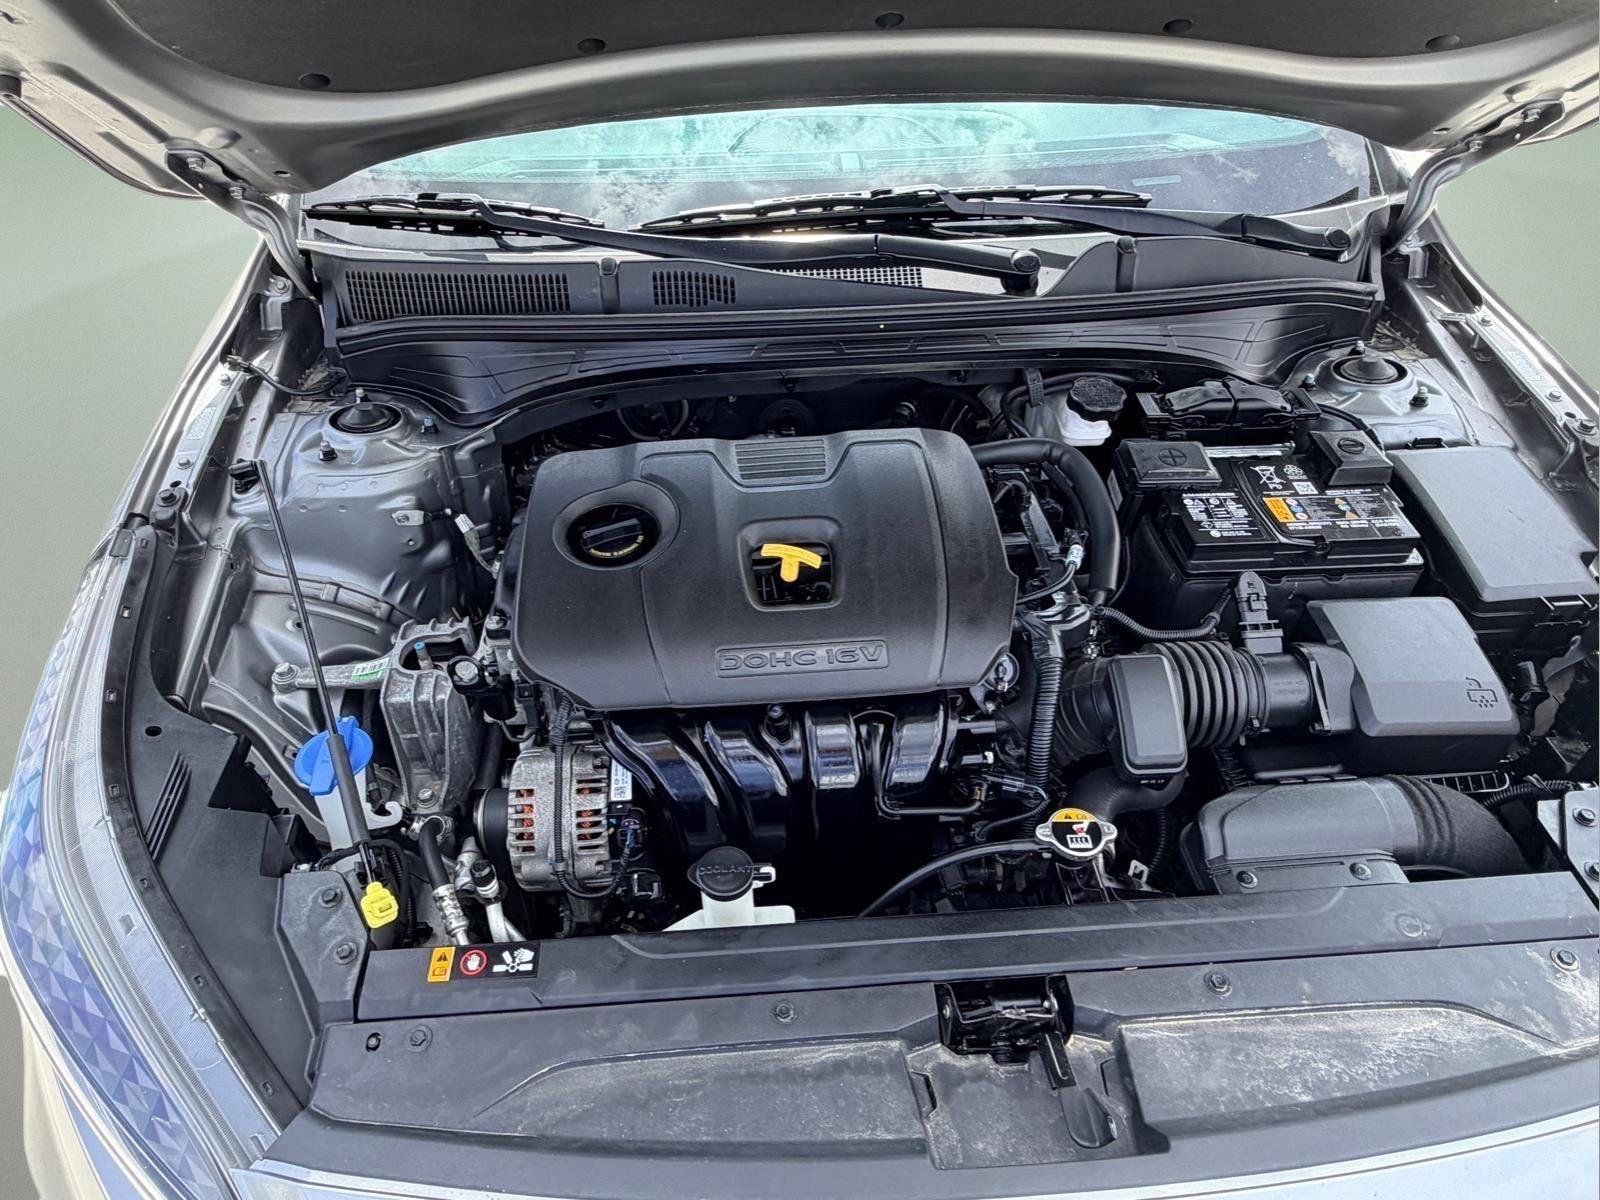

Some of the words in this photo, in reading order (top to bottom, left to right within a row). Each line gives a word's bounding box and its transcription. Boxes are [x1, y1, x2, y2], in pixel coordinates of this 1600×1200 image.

[719, 650, 817, 671] DOHC
[826, 645, 884, 665] 16V
[699, 865, 753, 875] COOLANT
